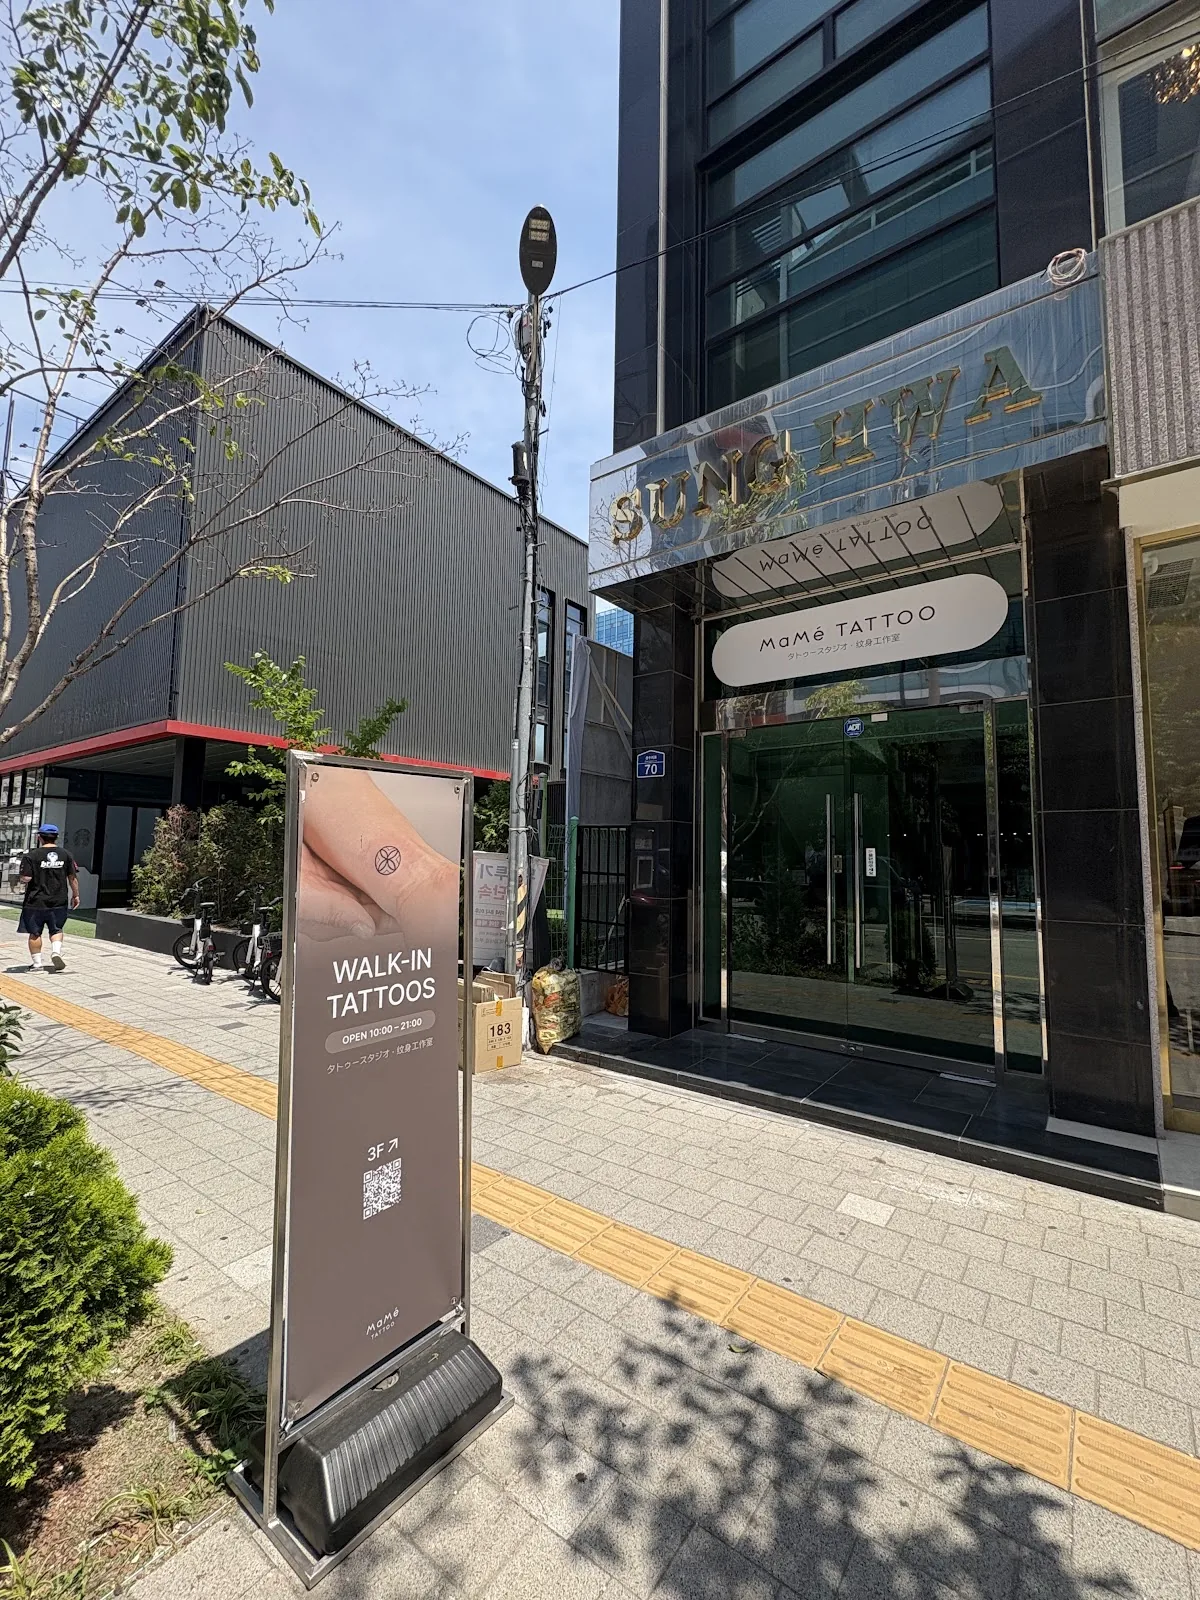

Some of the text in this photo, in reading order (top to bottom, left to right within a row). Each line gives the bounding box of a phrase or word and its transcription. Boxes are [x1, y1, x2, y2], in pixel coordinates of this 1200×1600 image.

[609, 345, 1043, 546] SUNG HWA
[835, 605, 936, 637] TATTOO
[847, 723, 861, 731] ADT
[644, 763, 658, 775] 70
[333, 948, 432, 984] WALK-IN
[327, 978, 436, 1019] TATTOOS
[342, 1030, 368, 1045] OPEN
[489, 1022, 512, 1038] 183
[367, 1142, 385, 1162] 3F
[370, 1321, 395, 1340] TATTOO
